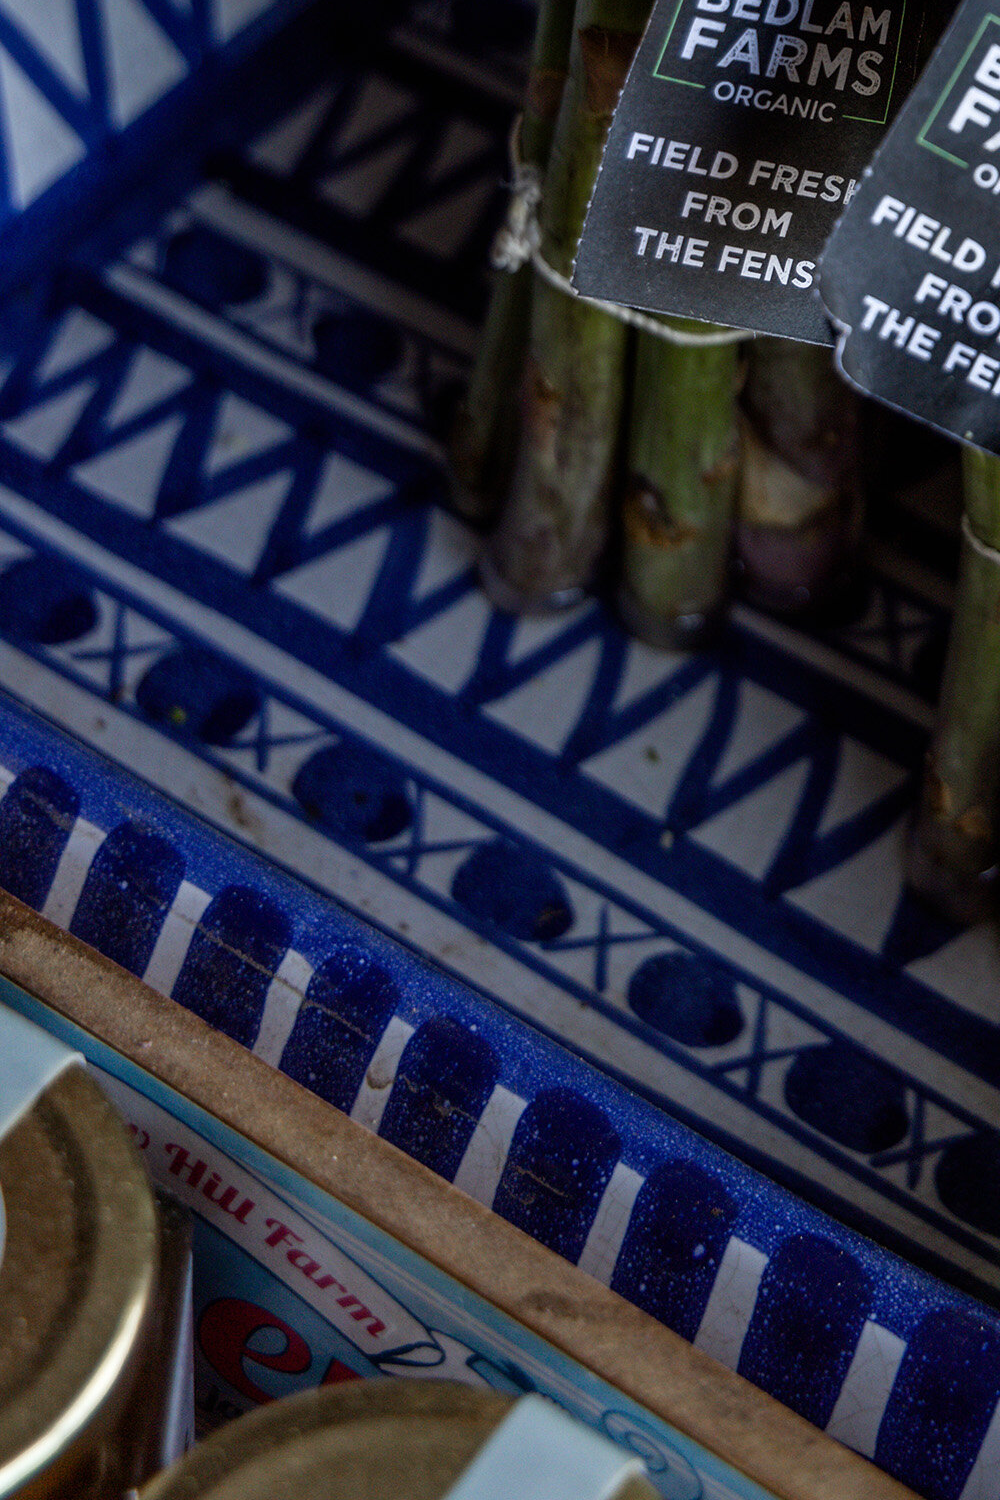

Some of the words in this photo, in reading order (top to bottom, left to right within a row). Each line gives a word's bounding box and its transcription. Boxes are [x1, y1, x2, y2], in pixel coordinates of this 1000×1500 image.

[680, 17, 885, 97] FARMS
[712, 79, 837, 123] ORGANIC
[626, 131, 739, 180] FIELD
[681, 190, 793, 238] FROM
[869, 195, 988, 276] FIELD
[634, 226, 710, 268] THE
[717, 245, 817, 289] FENS
[859, 294, 945, 363] THE
[165, 1143, 256, 1226] Hill
[264, 1218, 387, 1339] Farm
